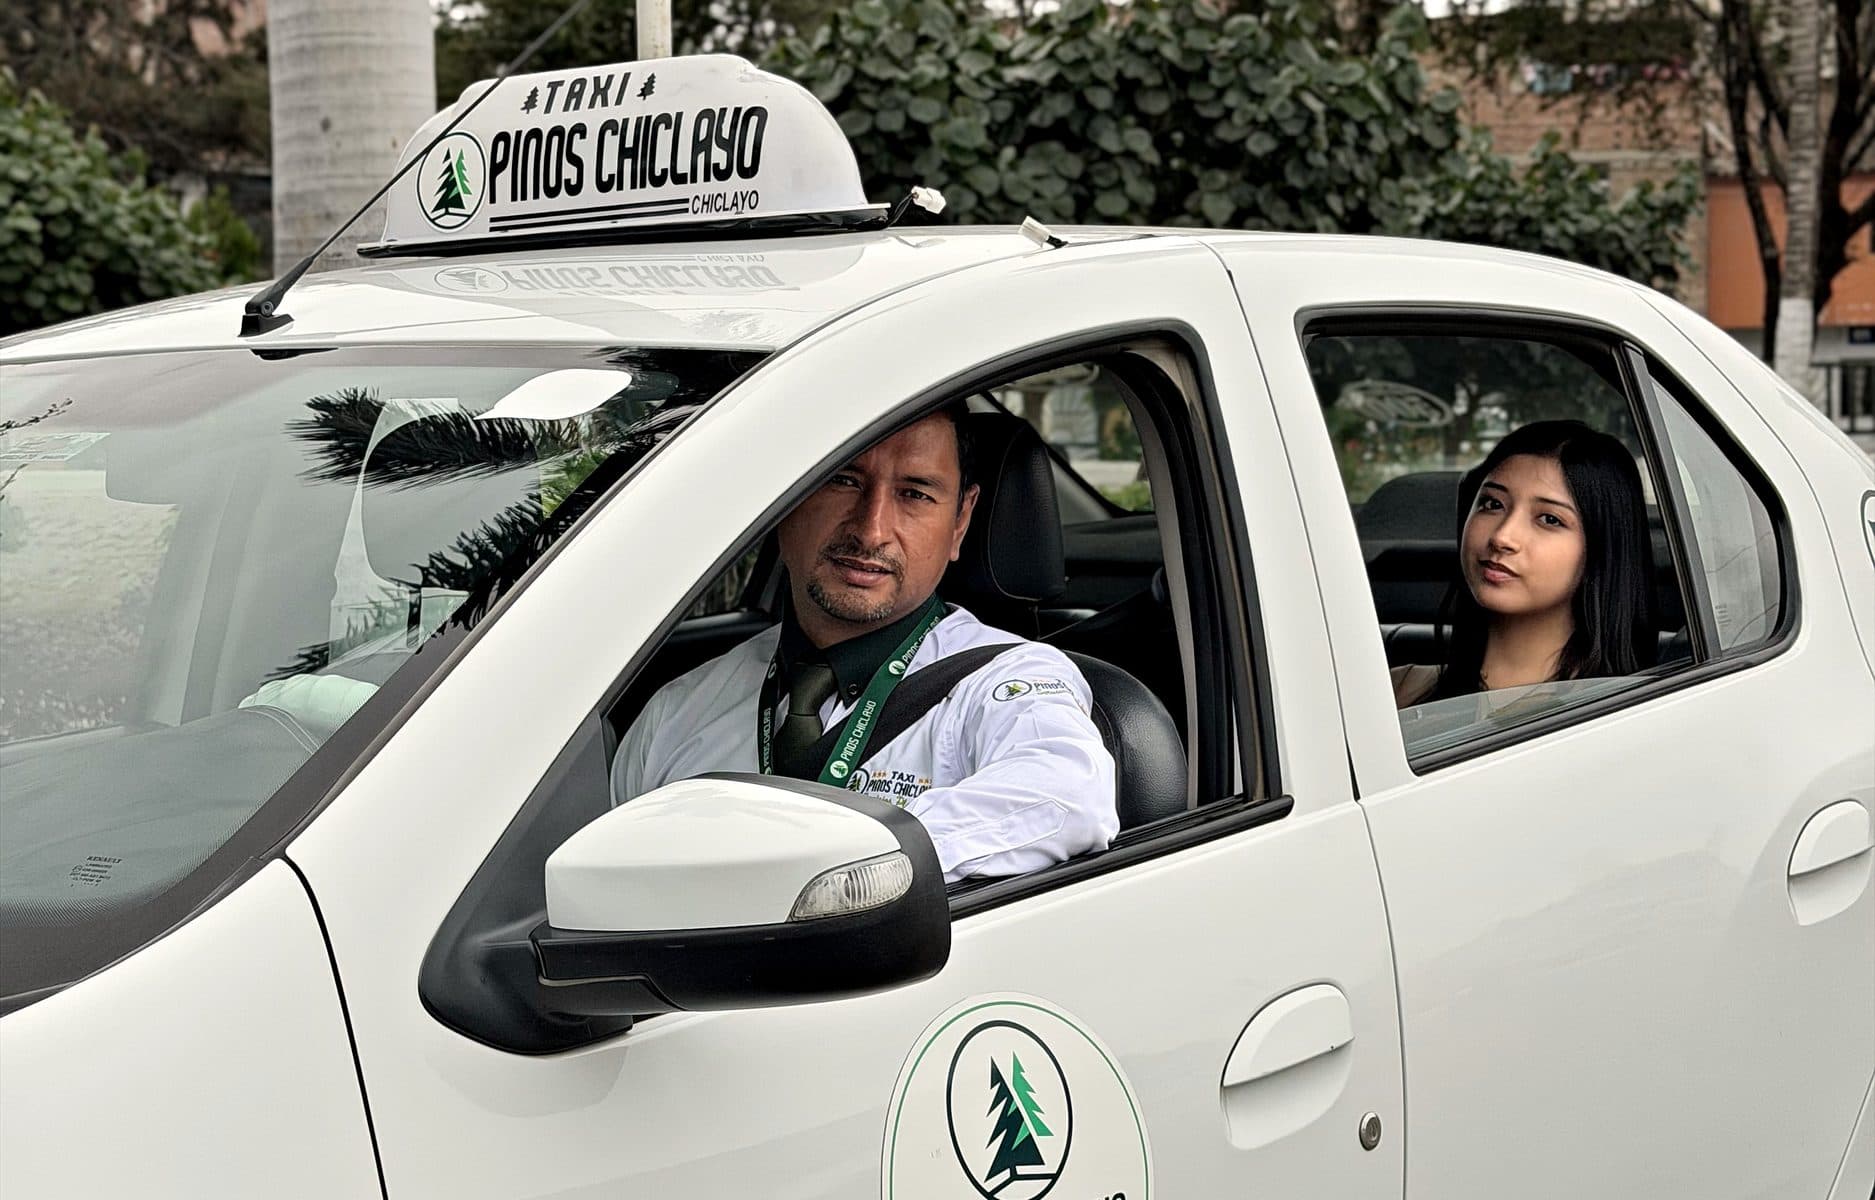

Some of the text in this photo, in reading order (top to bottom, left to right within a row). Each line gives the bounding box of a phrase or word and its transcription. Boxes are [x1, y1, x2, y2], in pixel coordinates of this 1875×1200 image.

[544, 72, 632, 115] TAXI
[489, 106, 768, 205] PINOS CHICLAYO
[691, 190, 759, 215] CHICLAYO
[840, 700, 877, 762] PINOS CHICLAYO
[866, 779, 932, 799] PINOS CHICLA
[891, 770, 916, 784] TAXI
